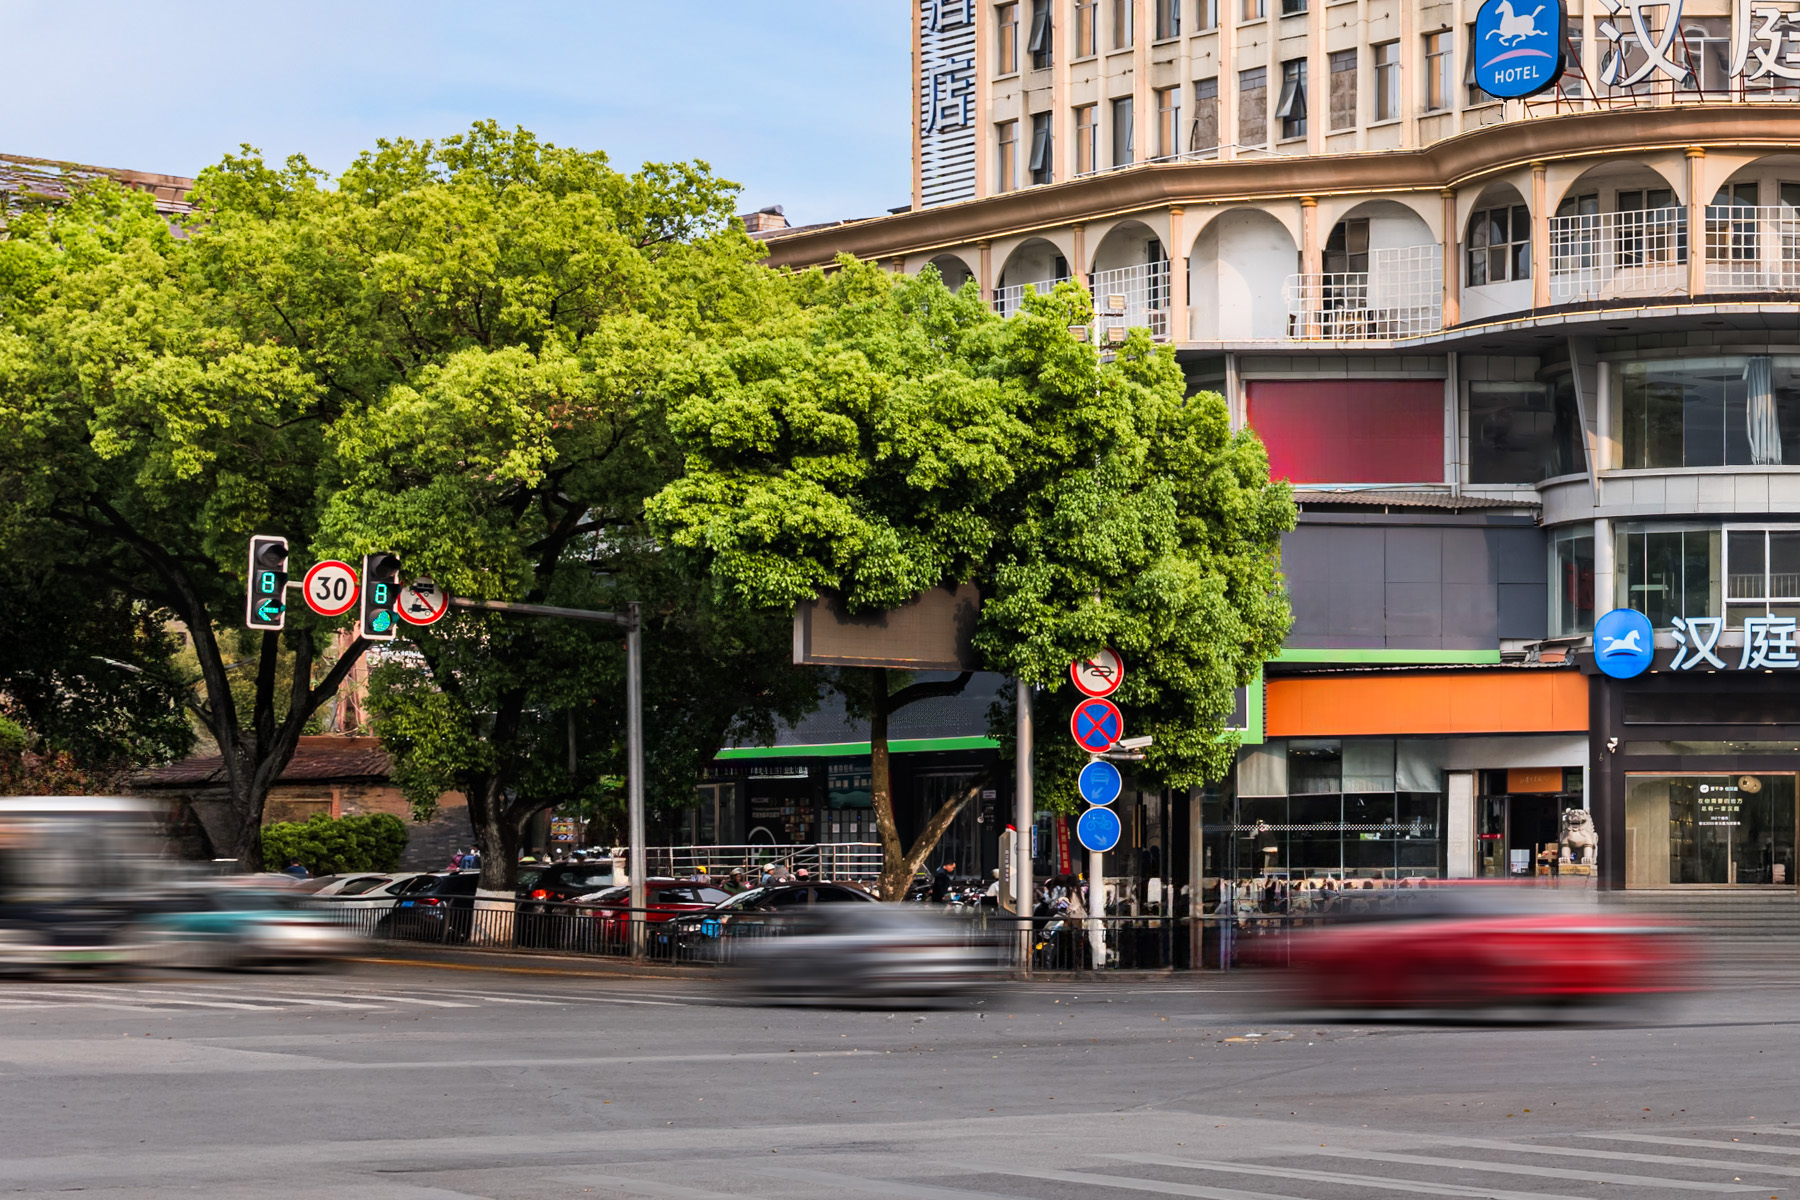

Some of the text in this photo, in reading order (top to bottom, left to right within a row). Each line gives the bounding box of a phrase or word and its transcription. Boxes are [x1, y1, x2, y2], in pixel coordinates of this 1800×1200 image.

[1494, 65, 1541, 86] HOTEL
[261, 572, 276, 593] 8
[316, 576, 348, 601] 30
[374, 583, 388, 605] 8
